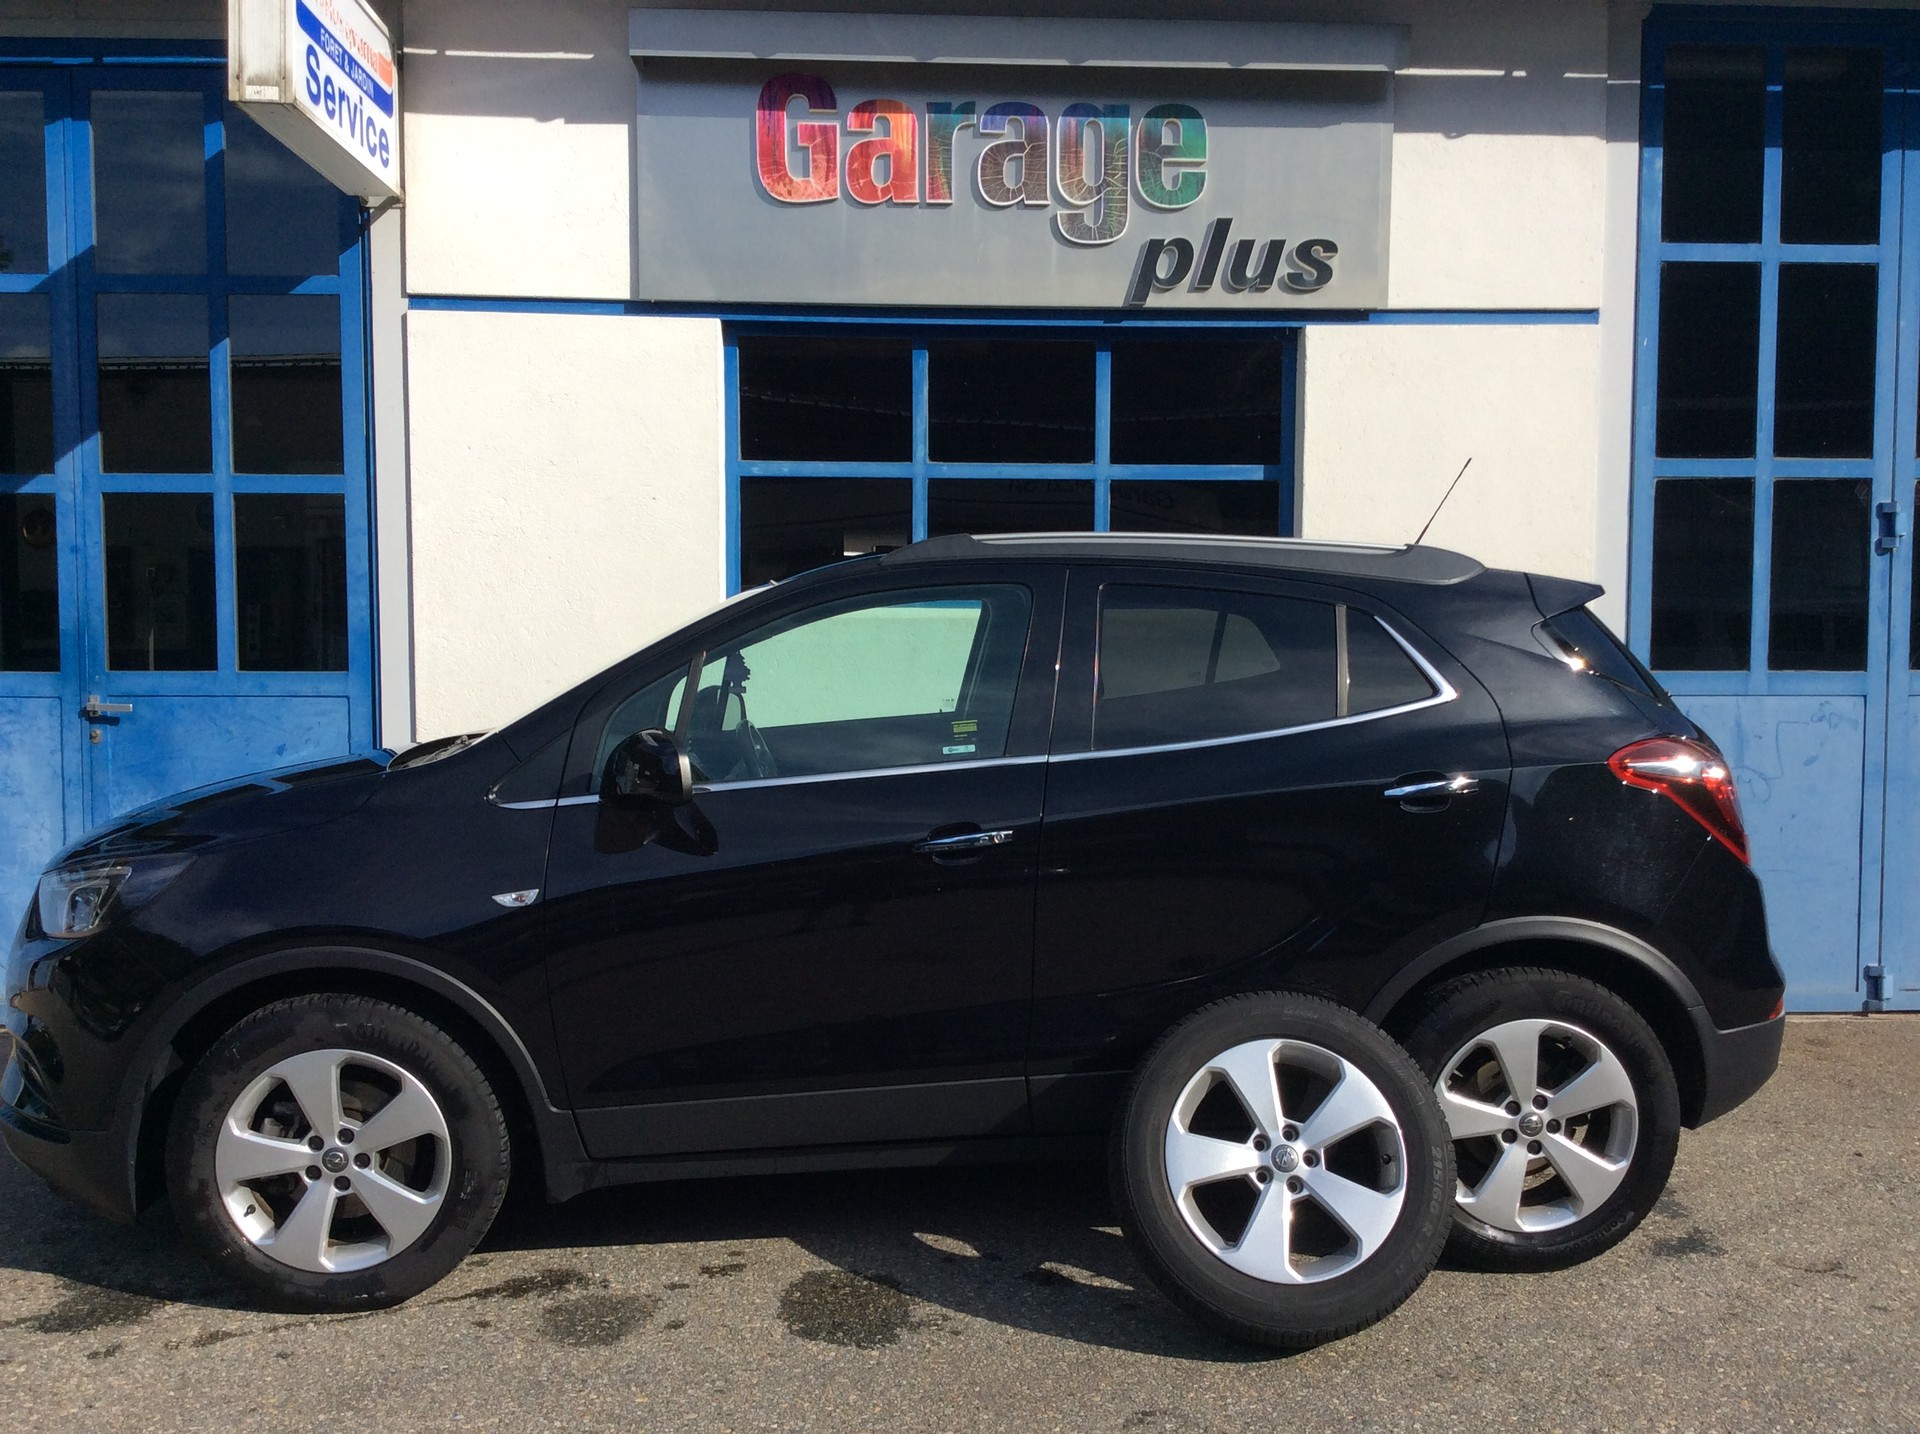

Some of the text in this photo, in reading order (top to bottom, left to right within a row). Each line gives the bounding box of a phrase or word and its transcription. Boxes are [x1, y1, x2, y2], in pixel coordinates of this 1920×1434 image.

[305, 44, 390, 168] Service
[319, 27, 375, 98] FORET & JARDIN
[756, 73, 1208, 244] Garage
[1129, 217, 1339, 305] plus
[1429, 1145, 1443, 1215] 215/60
